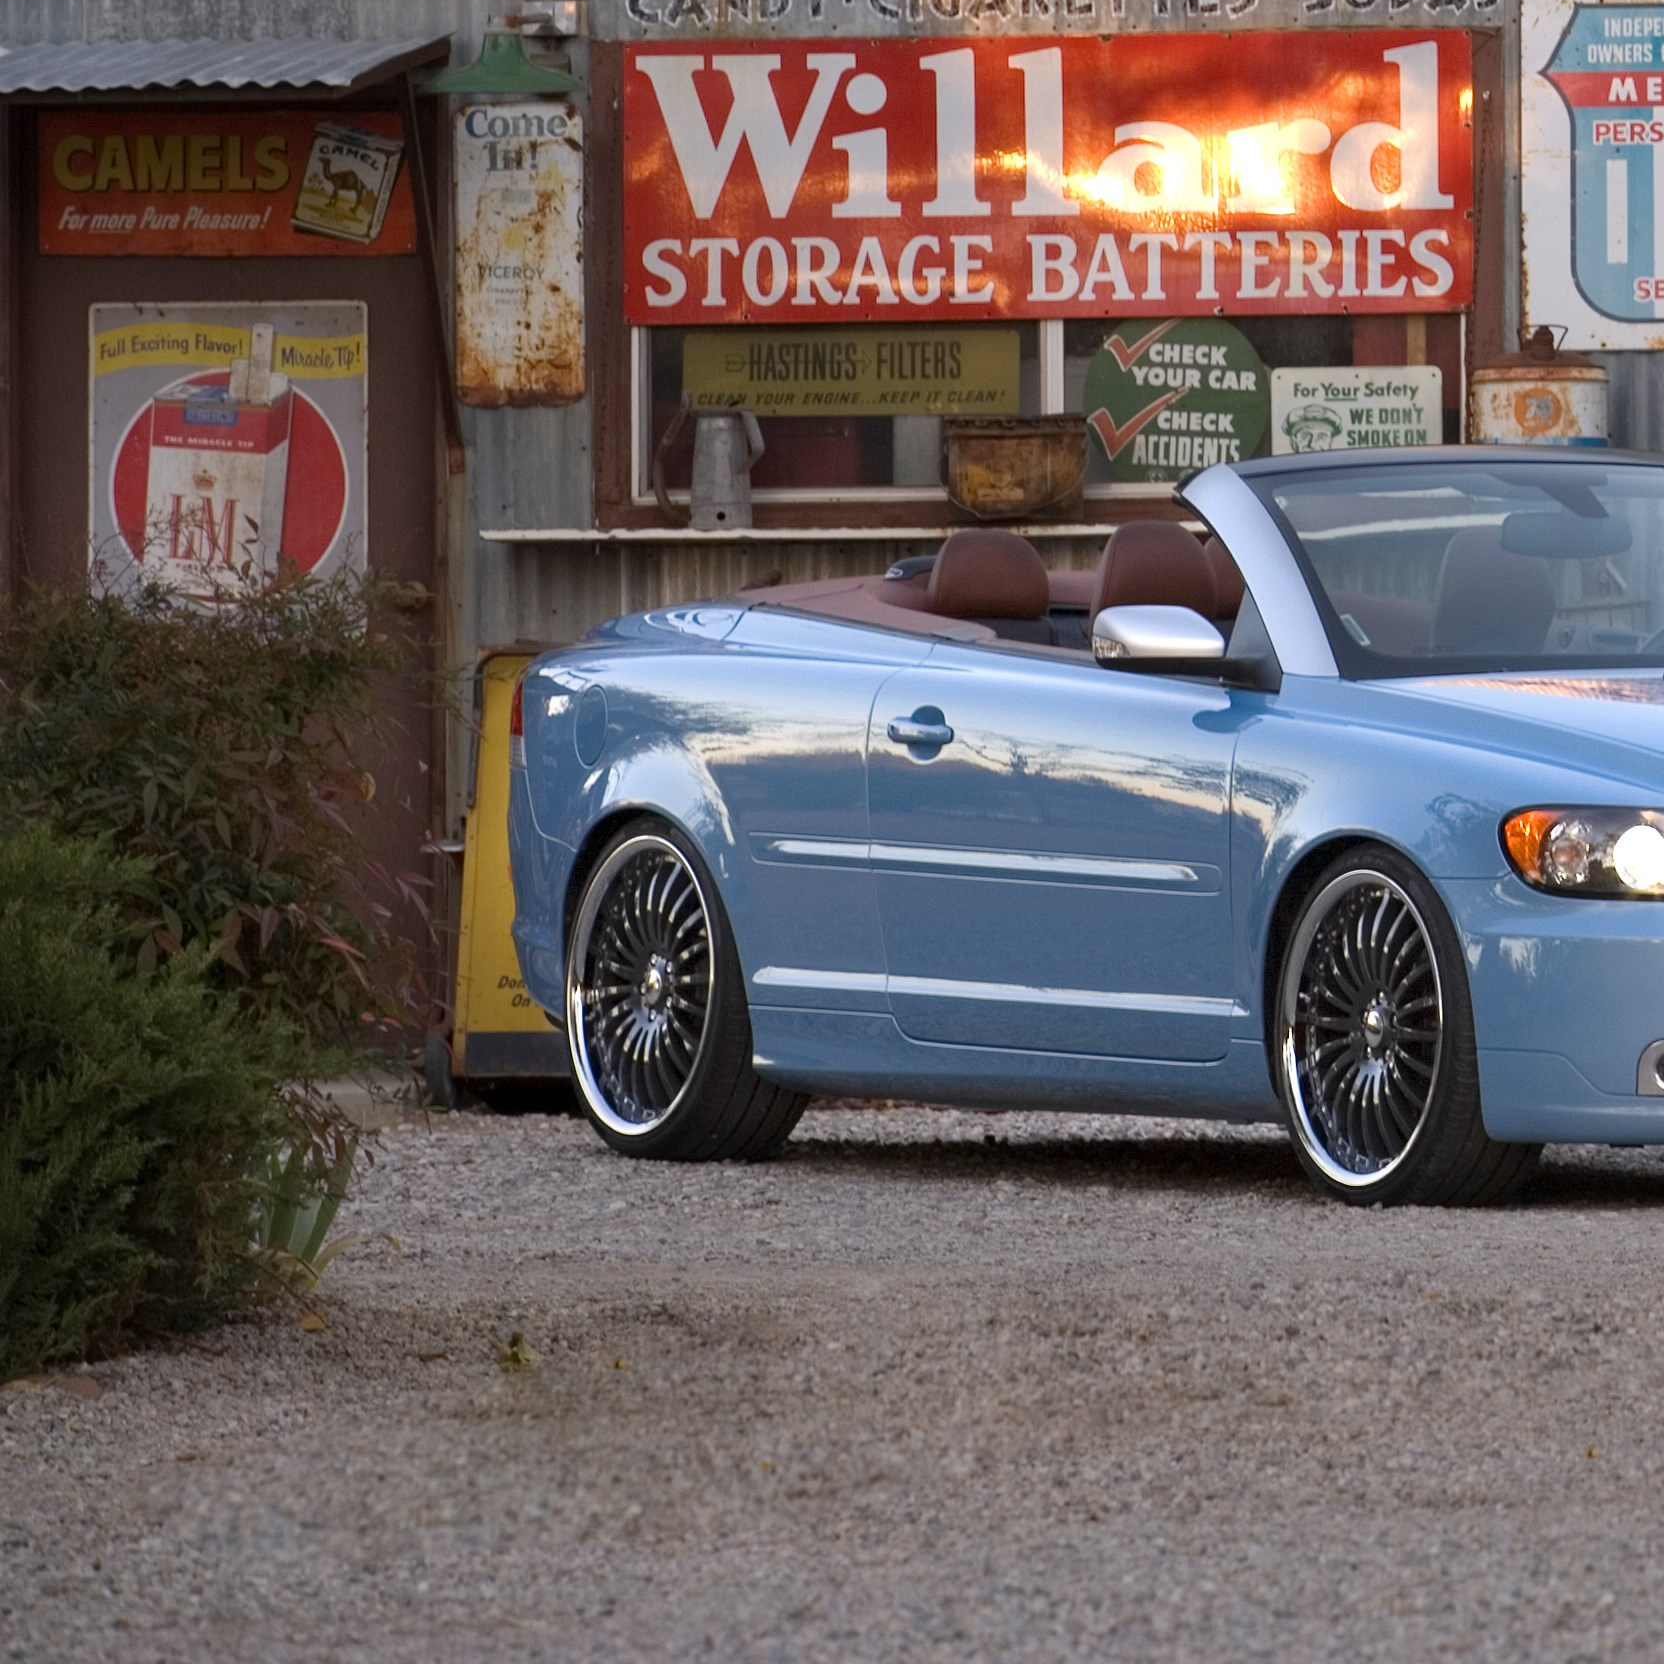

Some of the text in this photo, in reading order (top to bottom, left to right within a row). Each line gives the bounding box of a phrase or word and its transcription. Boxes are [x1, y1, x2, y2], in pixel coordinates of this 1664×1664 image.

[1587, 43, 1653, 64] OWNERS
[465, 109, 567, 139] Come
[636, 39, 1454, 219] Willard
[53, 135, 290, 193] CAMELS
[319, 144, 379, 171] CAMEL
[486, 140, 538, 172] In!
[58, 204, 272, 231] For more Pure Pleasure!
[642, 229, 1453, 307] STORAGE BATTERIES
[100, 333, 243, 360] Full Exciting Flavor!
[281, 341, 360, 369] Miracle Tip!
[1149, 343, 1227, 366] CHECK
[750, 340, 961, 382] HASTINGS FILTERS
[1131, 366, 1257, 391] YOUR CAR
[1293, 381, 1419, 401] For Your Safety
[698, 392, 747, 406] CLEAN
[756, 392, 794, 405] YOUR
[926, 391, 942, 404] IT
[947, 390, 1005, 404] CLEAN!
[1157, 410, 1235, 433] CHECK
[1349, 403, 1424, 425] WE DON'T
[164, 436, 254, 448] THE MIRACLE TIP
[1132, 434, 1241, 467] ACCIDENTS
[1347, 429, 1427, 446] SMOKE ON
